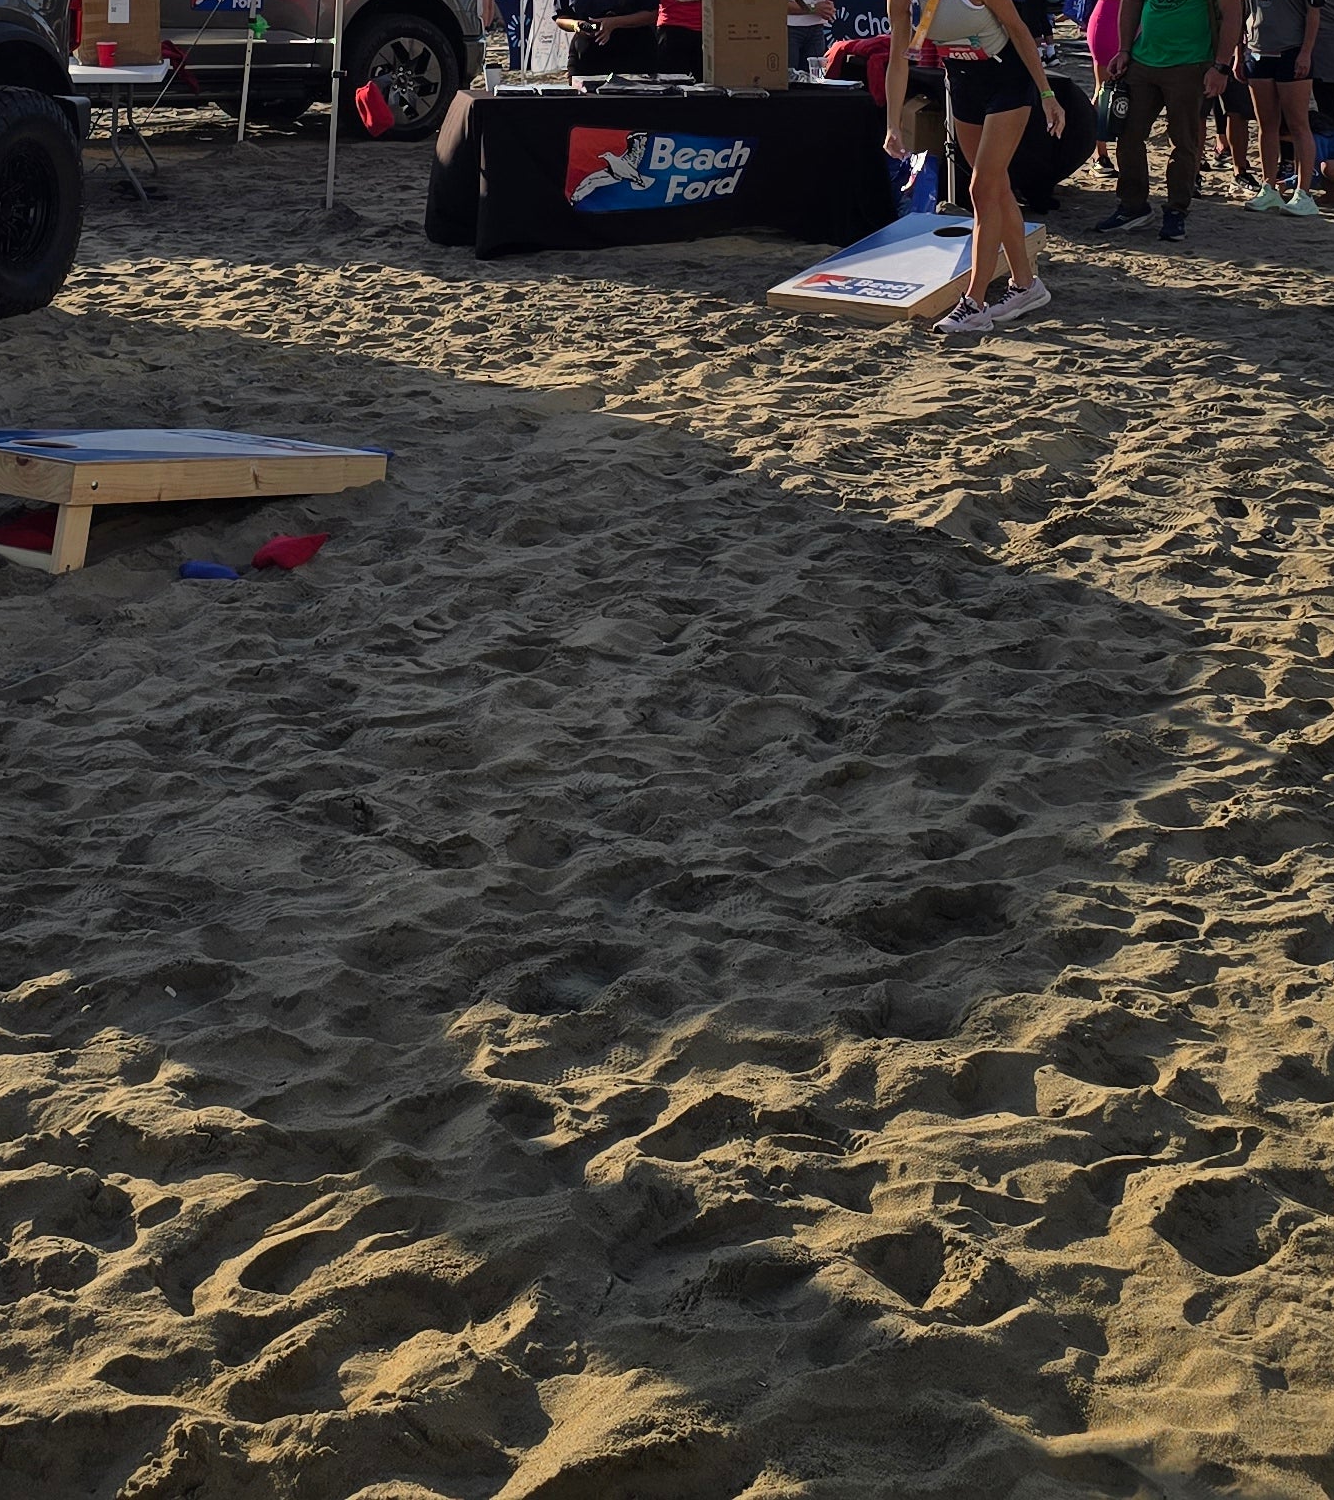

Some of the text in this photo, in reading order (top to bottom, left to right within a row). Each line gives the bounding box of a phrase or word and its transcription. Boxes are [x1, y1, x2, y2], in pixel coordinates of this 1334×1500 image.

[649, 136, 751, 170] Beach
[665, 168, 743, 203] Ford
[853, 279, 917, 292] Beach
[856, 287, 909, 298] Ford
